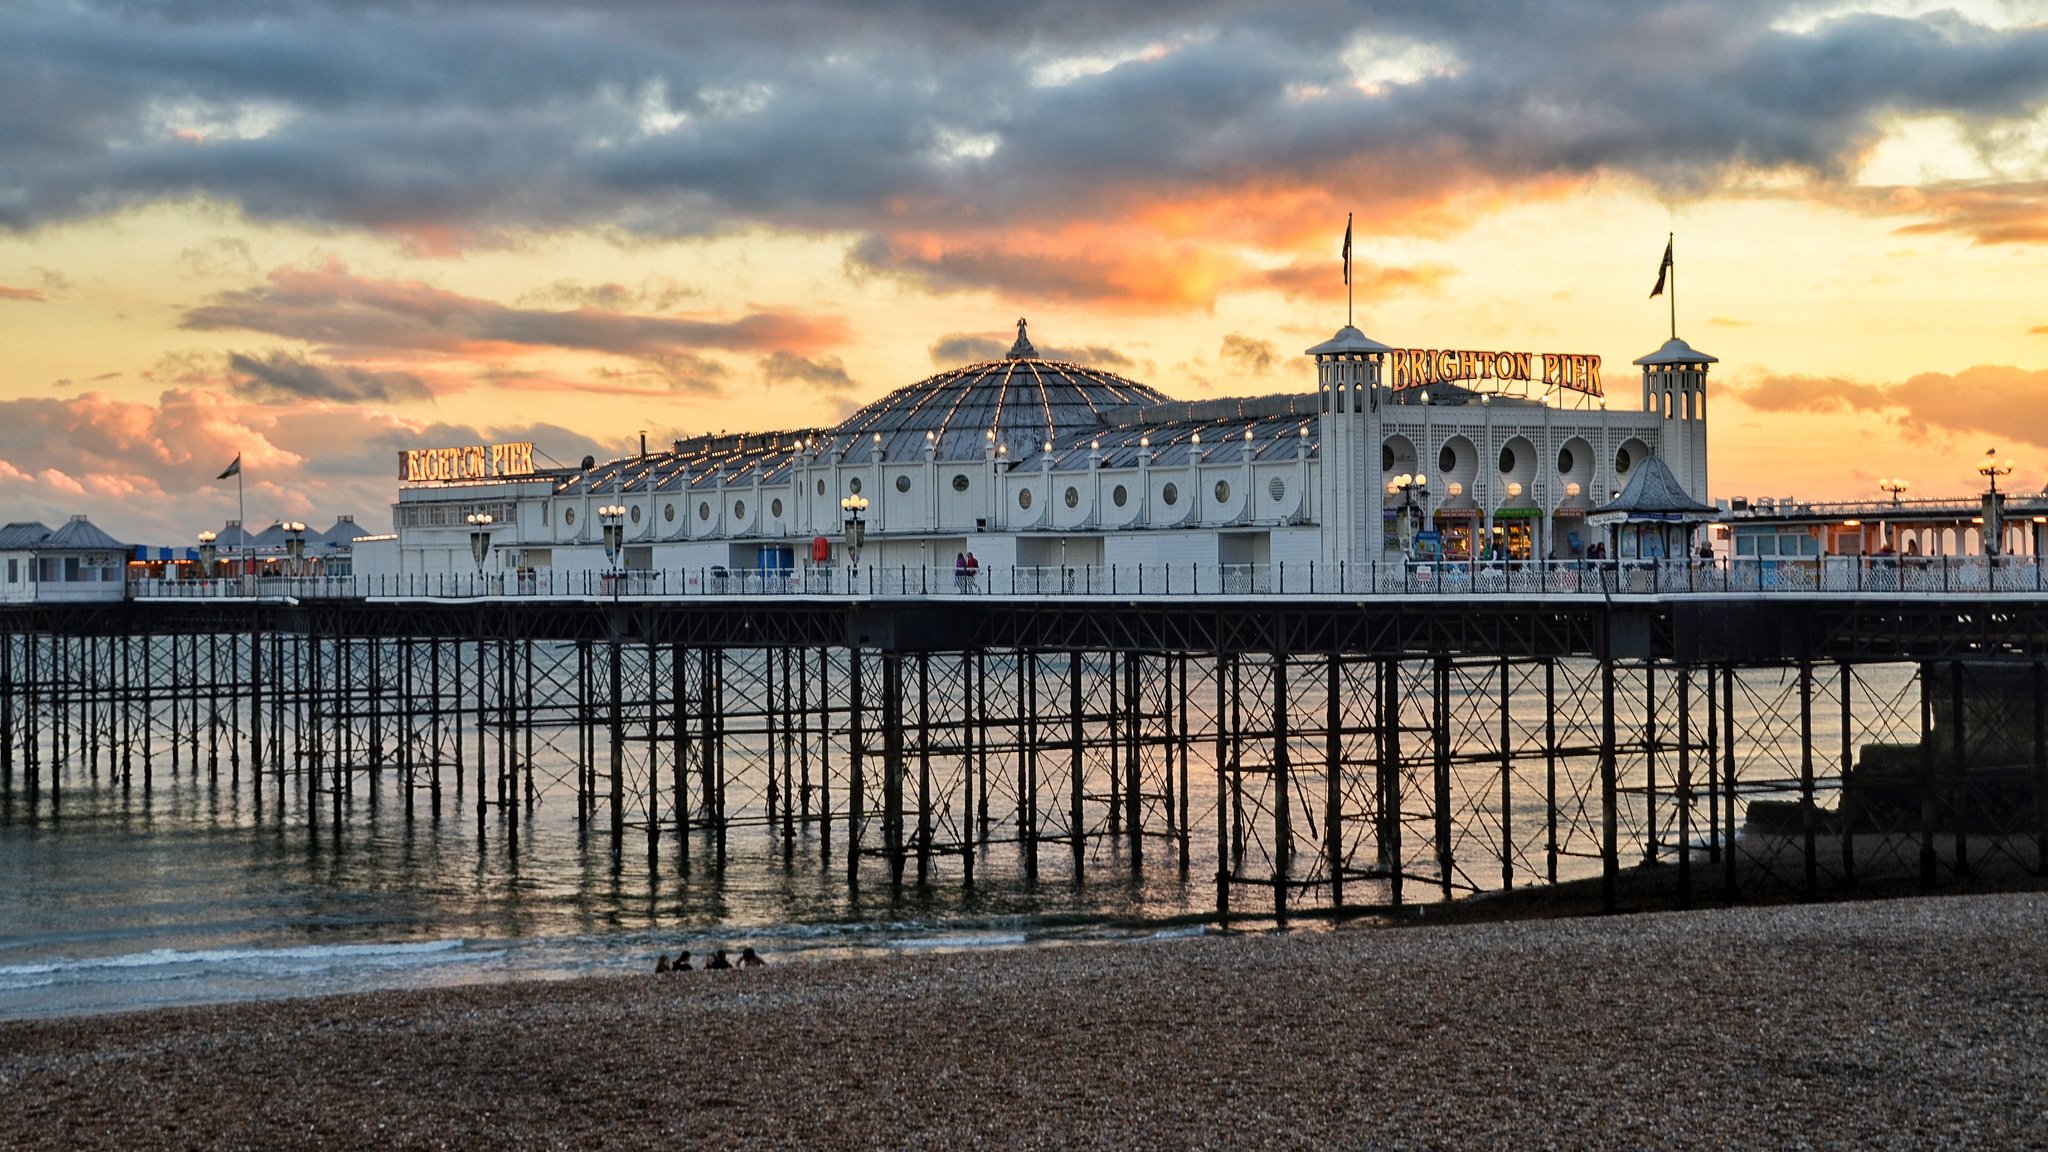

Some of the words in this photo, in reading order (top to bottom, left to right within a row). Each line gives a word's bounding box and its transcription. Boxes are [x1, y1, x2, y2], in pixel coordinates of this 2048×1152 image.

[1392, 348, 1532, 392] BRIGHTON
[1543, 353, 1604, 397] PIER
[491, 442, 535, 477] PIER
